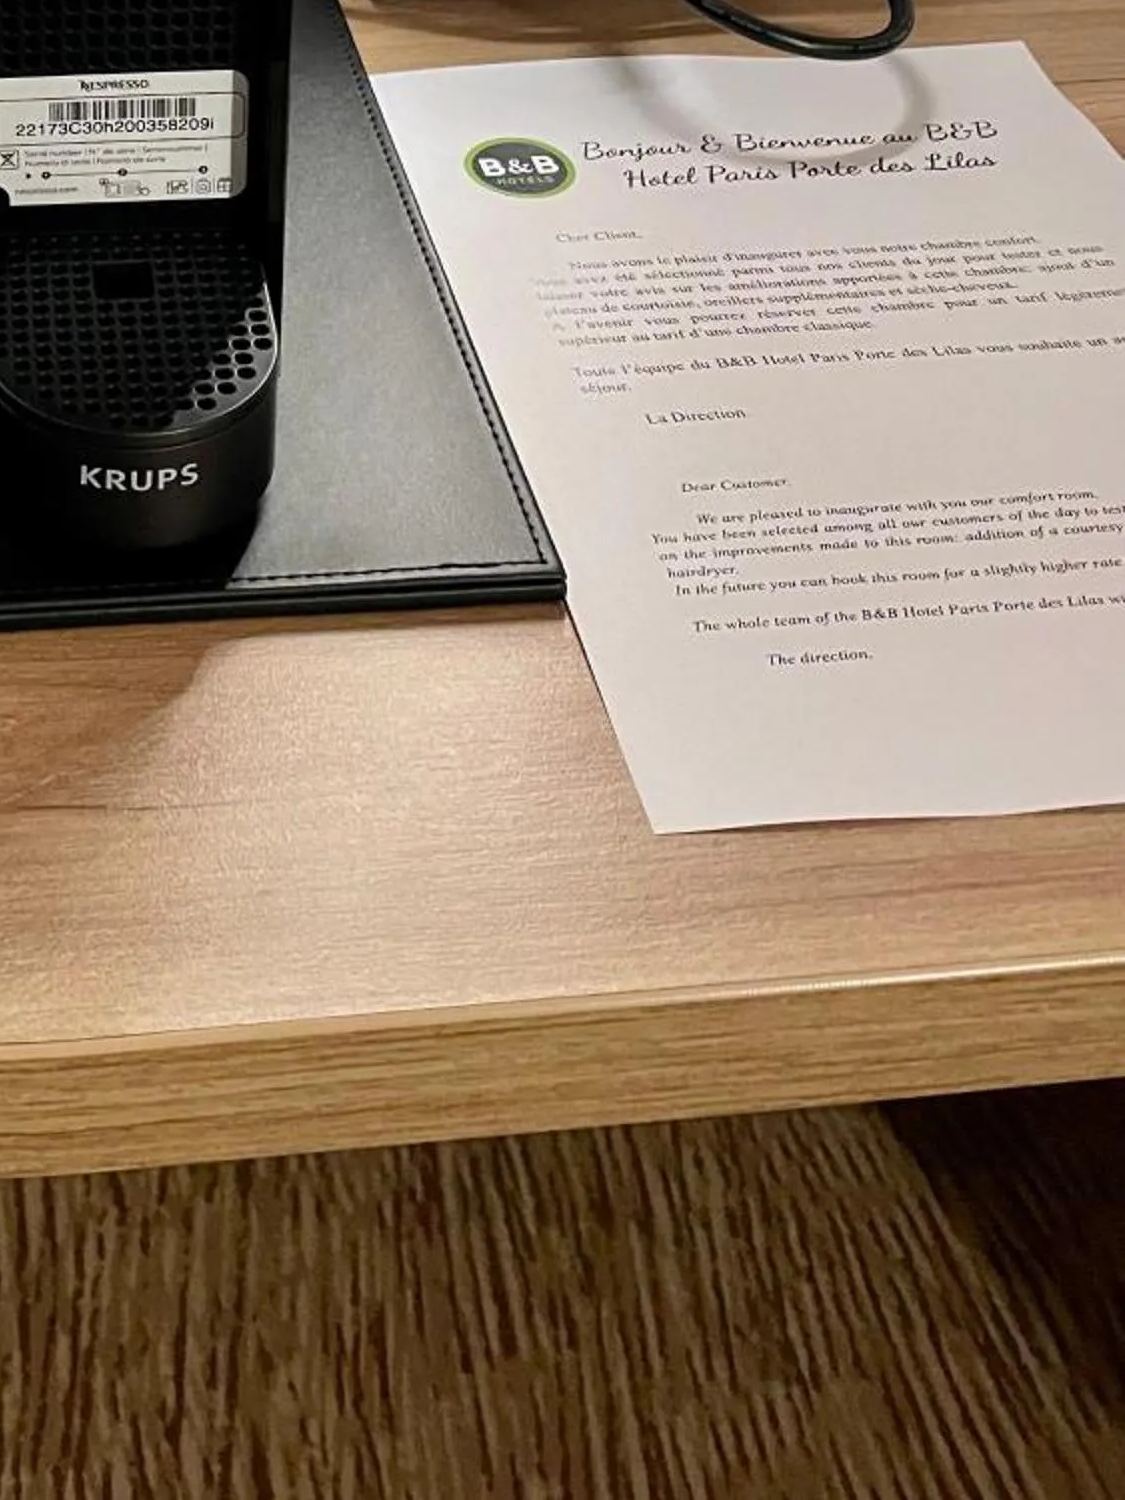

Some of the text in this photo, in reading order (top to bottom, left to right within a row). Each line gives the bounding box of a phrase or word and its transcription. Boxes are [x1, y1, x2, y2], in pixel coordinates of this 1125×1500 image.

[79, 78, 150, 93] NESPRESSO
[580, 120, 999, 163] Bonjour & Bienvenue au B&B
[477, 155, 560, 178] B&B
[622, 151, 998, 189] Hotel Paris Porte des Lilas
[922, 239, 980, 251] chambre
[716, 355, 757, 369] B&B
[763, 353, 805, 365] Hotel
[811, 352, 849, 363] Paris
[855, 350, 895, 361] Porte
[902, 347, 927, 358] des
[932, 345, 971, 357] Lilas
[977, 344, 1013, 353] vous
[646, 409, 746, 425] La Direction
[79, 463, 199, 492] KRUPS
[682, 482, 715, 493] Dear
[697, 513, 716, 524] We
[722, 515, 744, 523] are
[750, 506, 803, 524] pleased
[808, 509, 821, 517] to
[826, 503, 901, 517] inaugurate
[907, 499, 937, 511] with
[941, 500, 967, 510] you
[971, 497, 993, 507] our
[999, 491, 1054, 505] comfort
[652, 533, 678, 545] You
[683, 532, 716, 542] have
[722, 528, 756, 539] been
[762, 523, 818, 537] selected
[824, 523, 873, 533] among
[879, 518, 897, 531] all
[902, 519, 925, 529] our
[932, 514, 1004, 527] customers
[1009, 510, 1022, 522] of
[1028, 509, 1049, 520] the
[1055, 506, 1080, 519] day
[1084, 507, 1098, 517] to
[684, 549, 706, 560] the
[713, 542, 813, 560] improvements
[820, 539, 857, 551] made
[865, 539, 879, 549] to
[885, 536, 911, 547] this
[965, 529, 1024, 542] addition
[1030, 525, 1043, 540] of
[1049, 527, 1058, 536] a
[1064, 523, 1123, 535] courtesy
[676, 558, 1121, 596] In the future you can book this room for a slightly higher rate
[694, 595, 1104, 633] The whole team of the B&B Hotel Paris Porte des Lilas
[770, 651, 873, 666] The direction.
